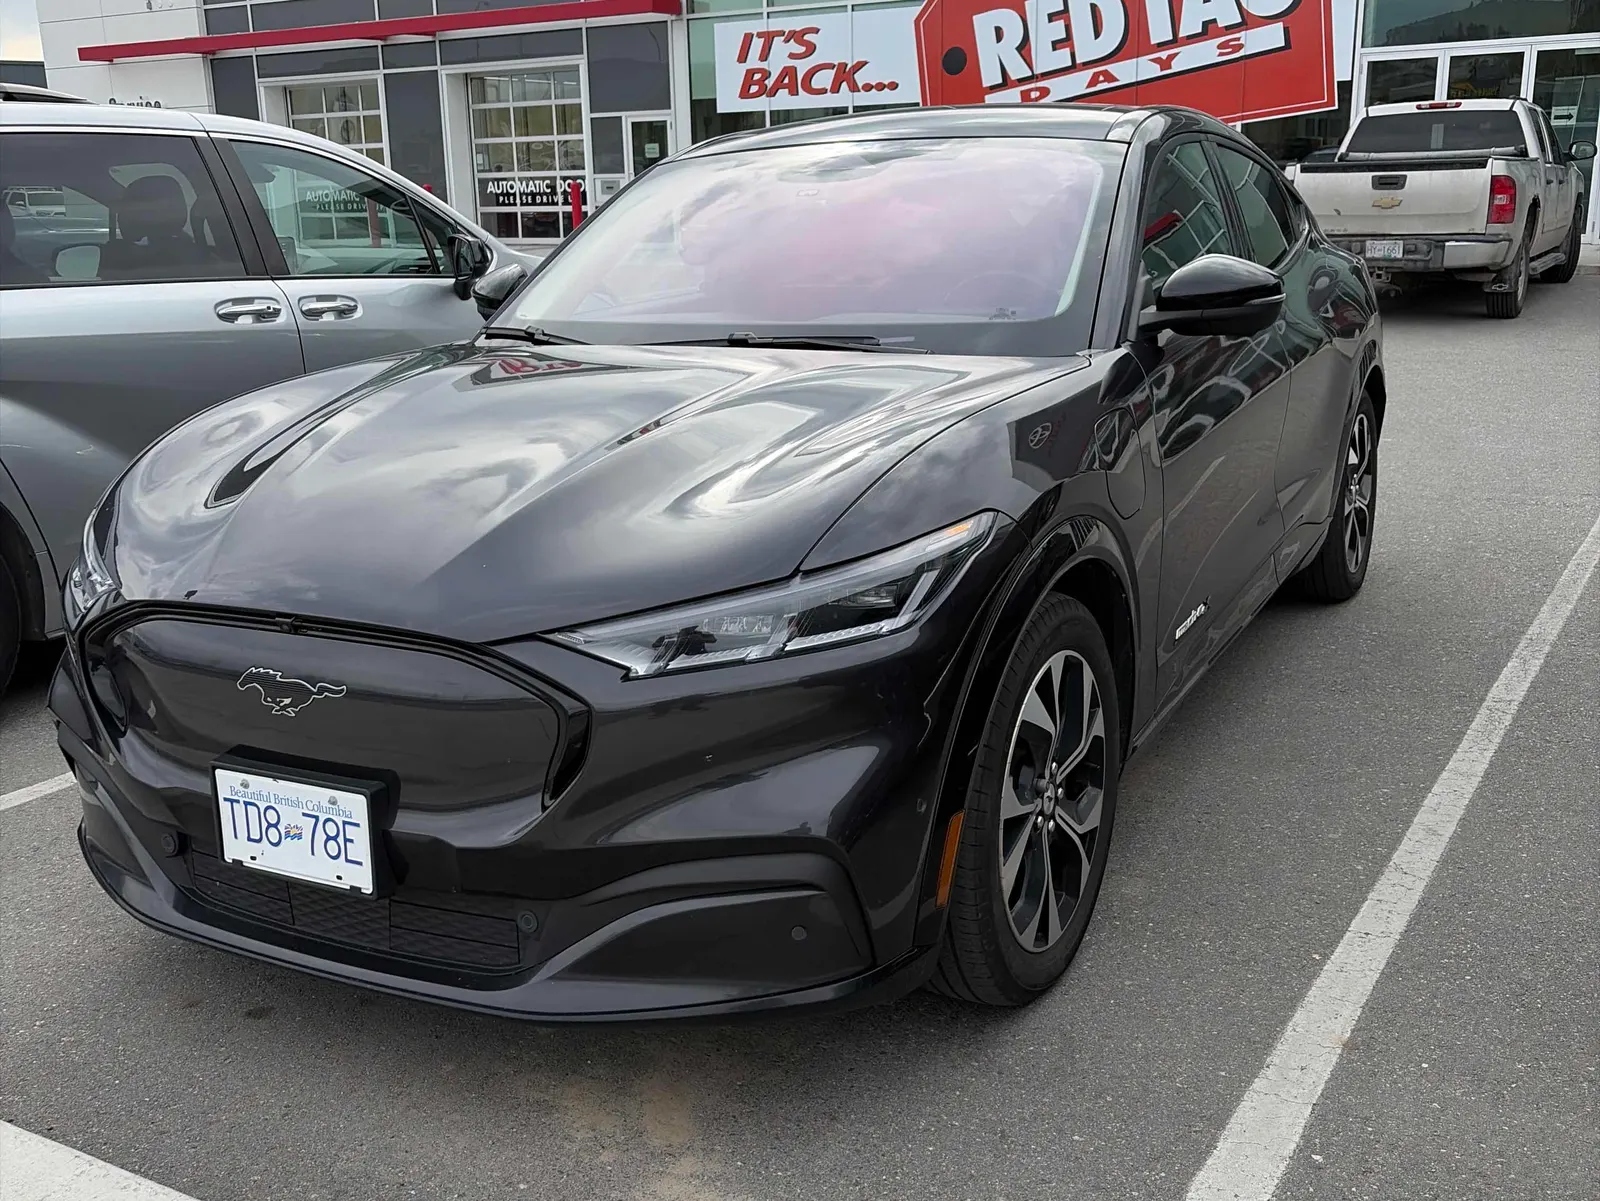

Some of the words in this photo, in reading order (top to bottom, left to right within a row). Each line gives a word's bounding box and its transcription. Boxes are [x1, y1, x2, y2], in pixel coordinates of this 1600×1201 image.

[737, 26, 820, 64] IT'S
[973, 0, 1128, 89] RED
[1146, 0, 1297, 46] TA
[738, 60, 899, 100] BACK...
[1019, 36, 1246, 103] DAYS
[306, 190, 359, 202] AUTOMATIC
[487, 180, 551, 194] AUTOMATIC
[229, 785, 272, 803] Beautiful
[274, 793, 304, 810] British
[306, 799, 353, 819] Columbia
[223, 797, 282, 847] TD8
[302, 812, 363, 866] 78E
